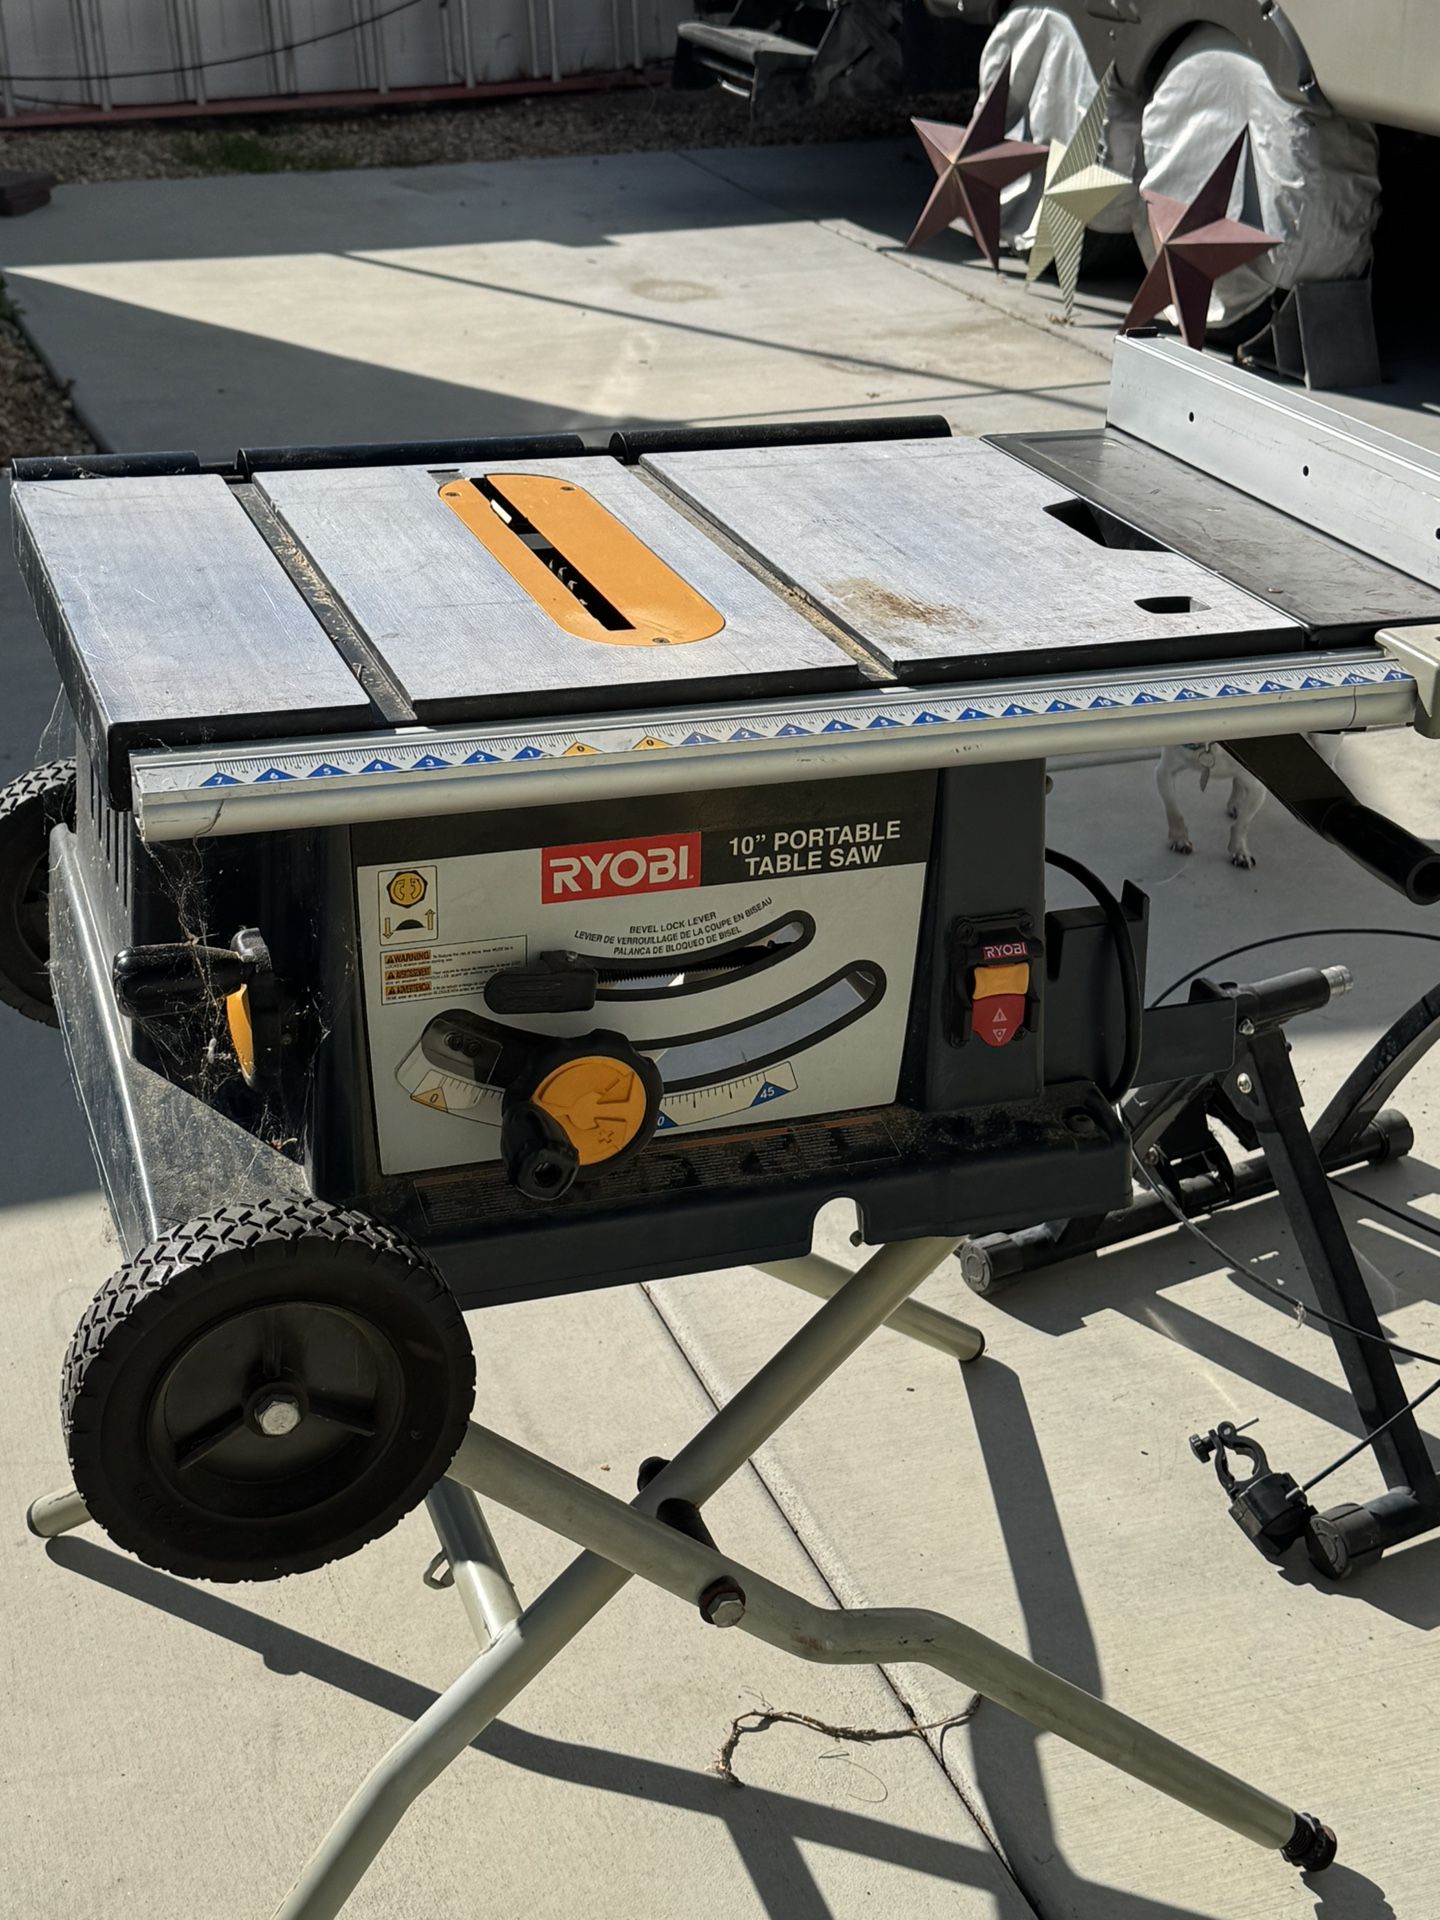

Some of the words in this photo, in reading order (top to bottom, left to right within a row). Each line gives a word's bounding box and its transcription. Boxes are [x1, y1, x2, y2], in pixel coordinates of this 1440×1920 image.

[214, 776, 222, 784] 7
[774, 820, 901, 852] PORTABLE
[550, 845, 688, 894] RYOBI
[745, 849, 822, 876] TABLE
[829, 844, 883, 868] SAW
[574, 930, 602, 942] LEVIER
[604, 935, 615, 944] DE
[617, 933, 678, 945] VERROUILLAGE
[680, 930, 691, 940] DE
[692, 928, 703, 937] LA
[704, 917, 733, 933] COUPE
[733, 912, 744, 923] EN
[744, 897, 772, 917] BISEAU
[630, 925, 658, 934] BEVEL
[660, 920, 685, 932] LOCK
[688, 911, 717, 926] LEVER
[613, 946, 651, 955] PALANCA
[653, 946, 663, 954] DE
[666, 938, 705, 953] BLOQUEO
[706, 934, 718, 944] DE
[718, 926, 742, 940] BISEL
[984, 943, 1026, 958] RYOBI
[430, 1094, 439, 1103] 0
[760, 1088, 775, 1098] 45
[657, 1116, 665, 1126] 0
